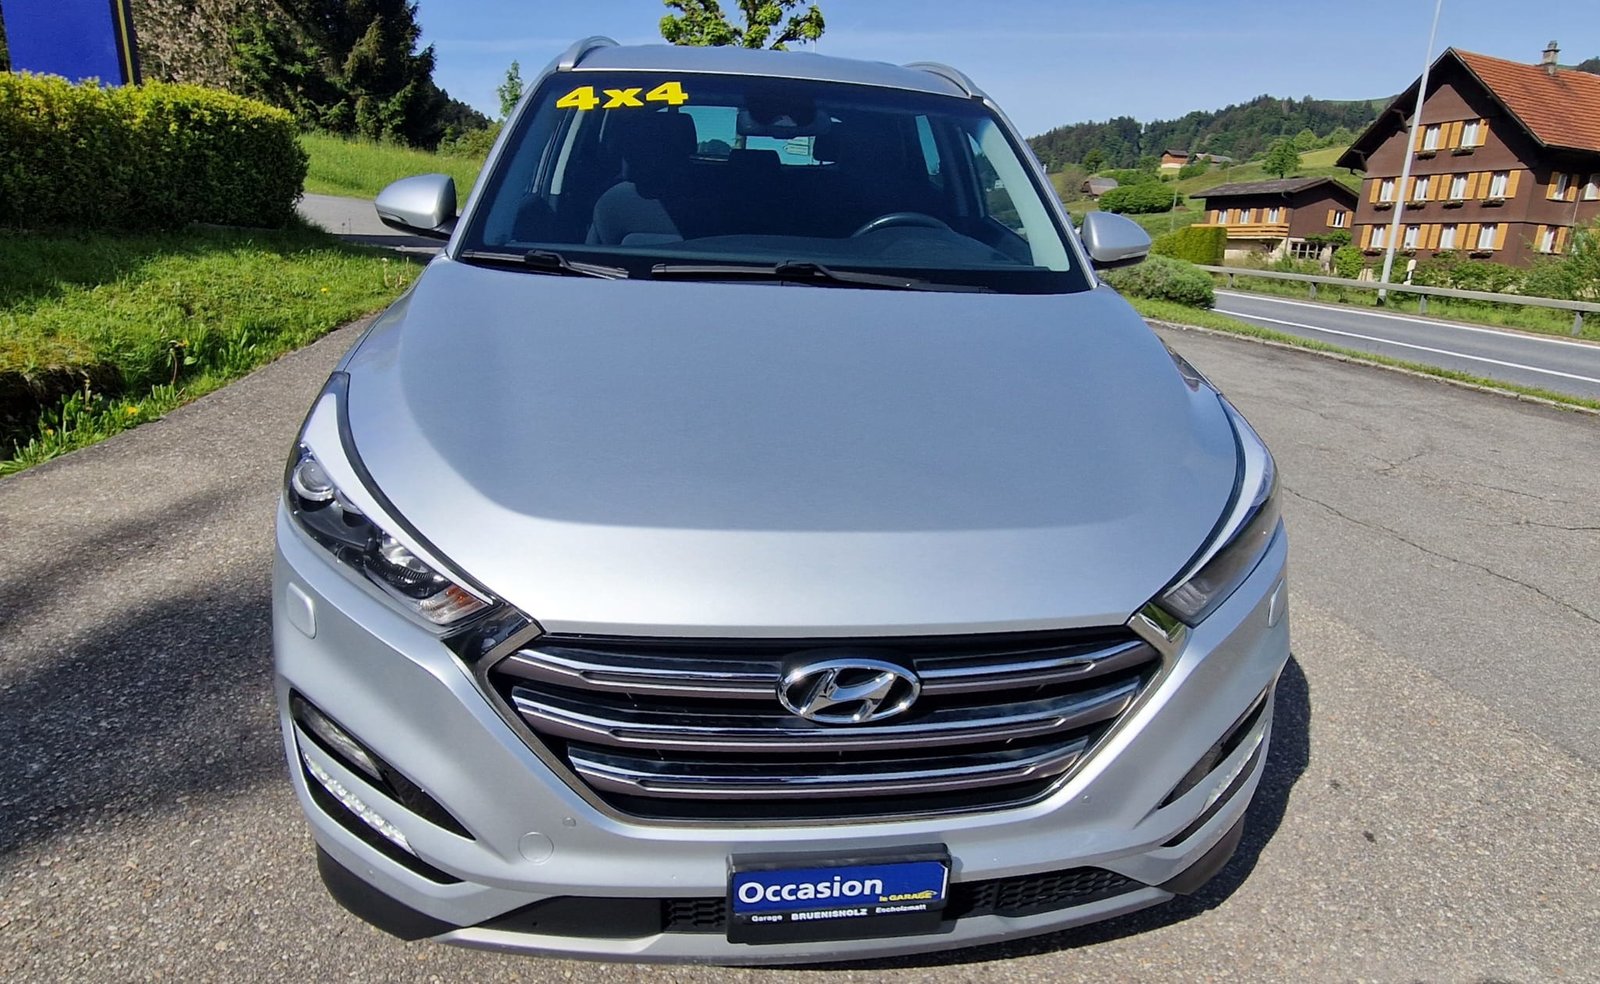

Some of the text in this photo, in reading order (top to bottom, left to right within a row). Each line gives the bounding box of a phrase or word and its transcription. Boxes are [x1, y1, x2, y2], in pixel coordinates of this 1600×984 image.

[556, 81, 689, 110] 4x4
[738, 876, 883, 904] Occasion
[888, 891, 932, 901] GARAGE
[751, 914, 783, 923] Garage
[875, 904, 927, 914] Escholzmatt
